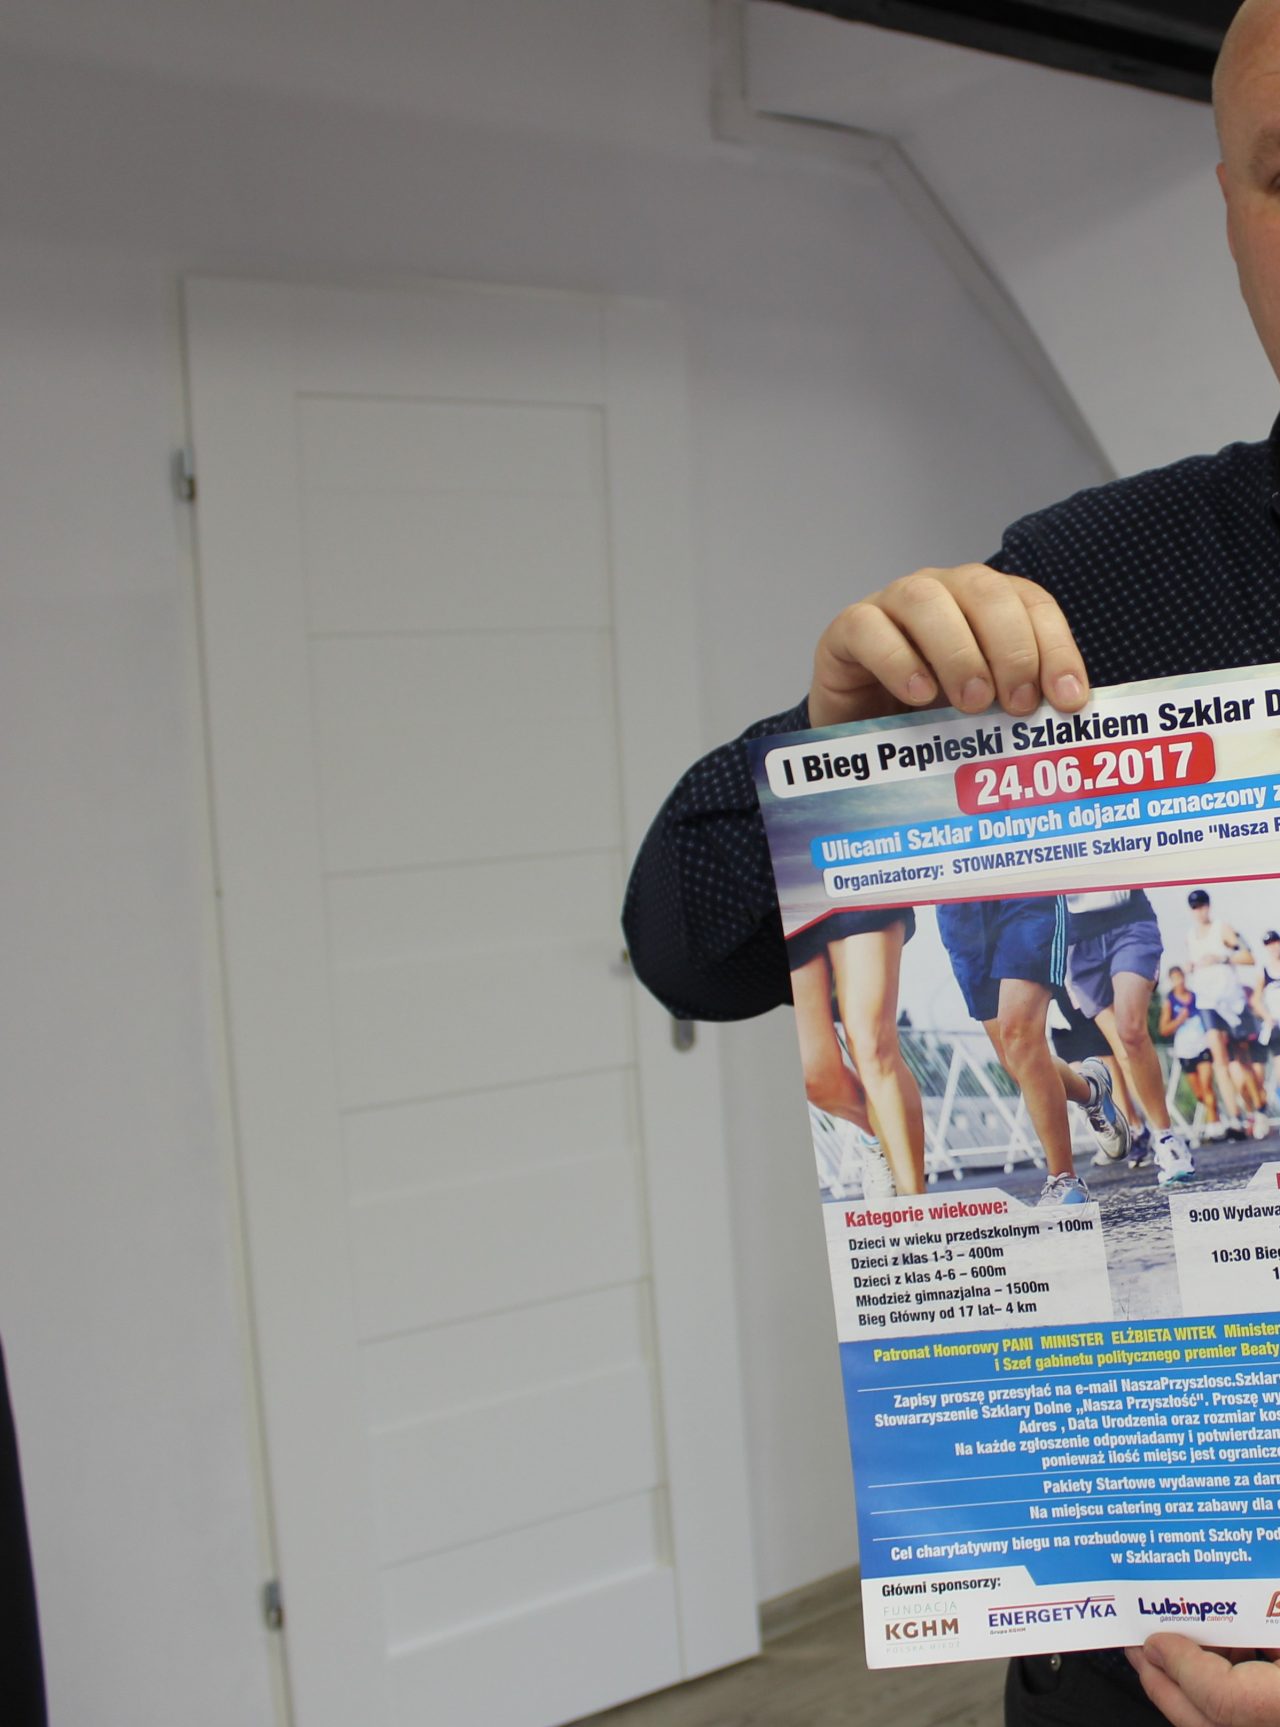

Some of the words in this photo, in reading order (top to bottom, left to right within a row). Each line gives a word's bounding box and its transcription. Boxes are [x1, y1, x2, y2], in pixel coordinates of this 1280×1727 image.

[782, 759, 794, 785] I
[802, 752, 870, 782] Bieg
[877, 725, 1003, 771] Papieski
[1011, 712, 1148, 751] Szlakiem
[1158, 696, 1255, 731] Szklar
[974, 741, 1193, 805] 24.06.2017
[821, 831, 902, 862] Ulicami
[907, 824, 973, 850] Szklar
[978, 809, 1062, 840] Dolnych
[1068, 798, 1140, 829] dojazd
[1147, 786, 1267, 817] oznaczony
[833, 865, 944, 891] Organizatorzy:
[952, 841, 1088, 874] STOWARZYSZENIE
[1092, 836, 1151, 855] Szklary
[1156, 829, 1203, 846] Dolne
[844, 1206, 924, 1228] Kategorie
[928, 1201, 1008, 1220] wiekowe:
[1189, 1207, 1220, 1223] 9:00
[848, 1236, 886, 1250] Dzieci
[904, 1232, 942, 1246] wieku
[945, 1224, 1040, 1245] przedszkolnym
[1056, 1218, 1093, 1232] 100m
[850, 1256, 888, 1270] Dzieci
[901, 1252, 928, 1265] klas
[932, 1249, 953, 1262] 1-3
[968, 1246, 1004, 1259] 400m
[1211, 1247, 1251, 1263] 10:30
[853, 1274, 891, 1288] Dzieci
[904, 1271, 931, 1284] klas
[934, 1268, 956, 1280] 4-6
[970, 1265, 1006, 1278] 600m
[855, 1292, 911, 1307] Młodzież
[914, 1285, 991, 1304] gimnazjalna
[1006, 1280, 1049, 1294] 1500m
[858, 1313, 886, 1327] Bieg
[889, 1310, 935, 1323] Główny
[939, 1306, 955, 1319] od
[959, 1305, 973, 1317] 17
[1016, 1301, 1037, 1313] km
[873, 1345, 930, 1362] Patronat
[933, 1342, 999, 1357] Honorowy
[1002, 1337, 1034, 1352] PANI
[1040, 1332, 1104, 1349] MINISTER
[1111, 1328, 1172, 1344] ELŻBIETA
[1173, 1325, 1216, 1341] WITEK
[1002, 1355, 1031, 1371] Szef
[1035, 1353, 1093, 1371] gabinetu
[1096, 1349, 1181, 1367] politycznego
[1184, 1344, 1237, 1362] premier
[1240, 1342, 1280, 1357] Beaty
[893, 1392, 937, 1409] Zapisy
[940, 1390, 984, 1407] proszę
[988, 1383, 1052, 1403] przesyłać
[1054, 1385, 1072, 1396] na
[1074, 1379, 1118, 1395] e-mail
[874, 1409, 978, 1427] Stowarzyszenie
[981, 1404, 1030, 1419] Szklary
[1033, 1401, 1072, 1415] Dolne
[1212, 1392, 1258, 1407] Proszę
[1018, 1419, 1057, 1434] Adres
[1067, 1416, 1098, 1430] Data
[1101, 1414, 1168, 1428] Urodzenia
[1170, 1414, 1200, 1426] oraz
[1203, 1411, 1256, 1424] rozmiar
[954, 1442, 973, 1456] Na
[976, 1439, 1016, 1454] każde
[1019, 1436, 1090, 1453] zgłoszenie
[1093, 1431, 1185, 1448] odpowiadamy
[1041, 1452, 1105, 1470] ponieważ
[1108, 1450, 1140, 1463] ilość
[1143, 1448, 1187, 1464] miejsc
[1190, 1447, 1215, 1463] jest
[1042, 1479, 1092, 1494] Pakiety
[1095, 1476, 1156, 1491] Startowe
[1158, 1474, 1230, 1491] wydawane
[1029, 1506, 1048, 1519] Na
[1051, 1503, 1104, 1519] miejscu
[1106, 1500, 1162, 1516] catering
[1164, 1502, 1194, 1513] oraz
[1197, 1498, 1248, 1513] zabawy
[1252, 1497, 1274, 1510] dla
[890, 1545, 913, 1561] Cel
[916, 1540, 1008, 1559] charytatywny
[1011, 1536, 1050, 1552] biegu
[1053, 1536, 1070, 1547] na
[1073, 1530, 1147, 1547] rozbudowę
[1158, 1529, 1205, 1543] remont
[1208, 1528, 1252, 1544] Szkoły
[1126, 1549, 1190, 1564] Szklarach
[1193, 1548, 1252, 1564] Dolnych.
[881, 1581, 926, 1597] Główni
[930, 1577, 1001, 1594] sponsorzy:
[884, 1601, 958, 1616] FUNDACJA
[988, 1598, 1117, 1628] ENERGETYKA
[1138, 1597, 1238, 1622] Lubinpex
[1160, 1615, 1200, 1623] gastronomia
[1206, 1614, 1234, 1623] catering
[885, 1618, 959, 1640] KGHM
